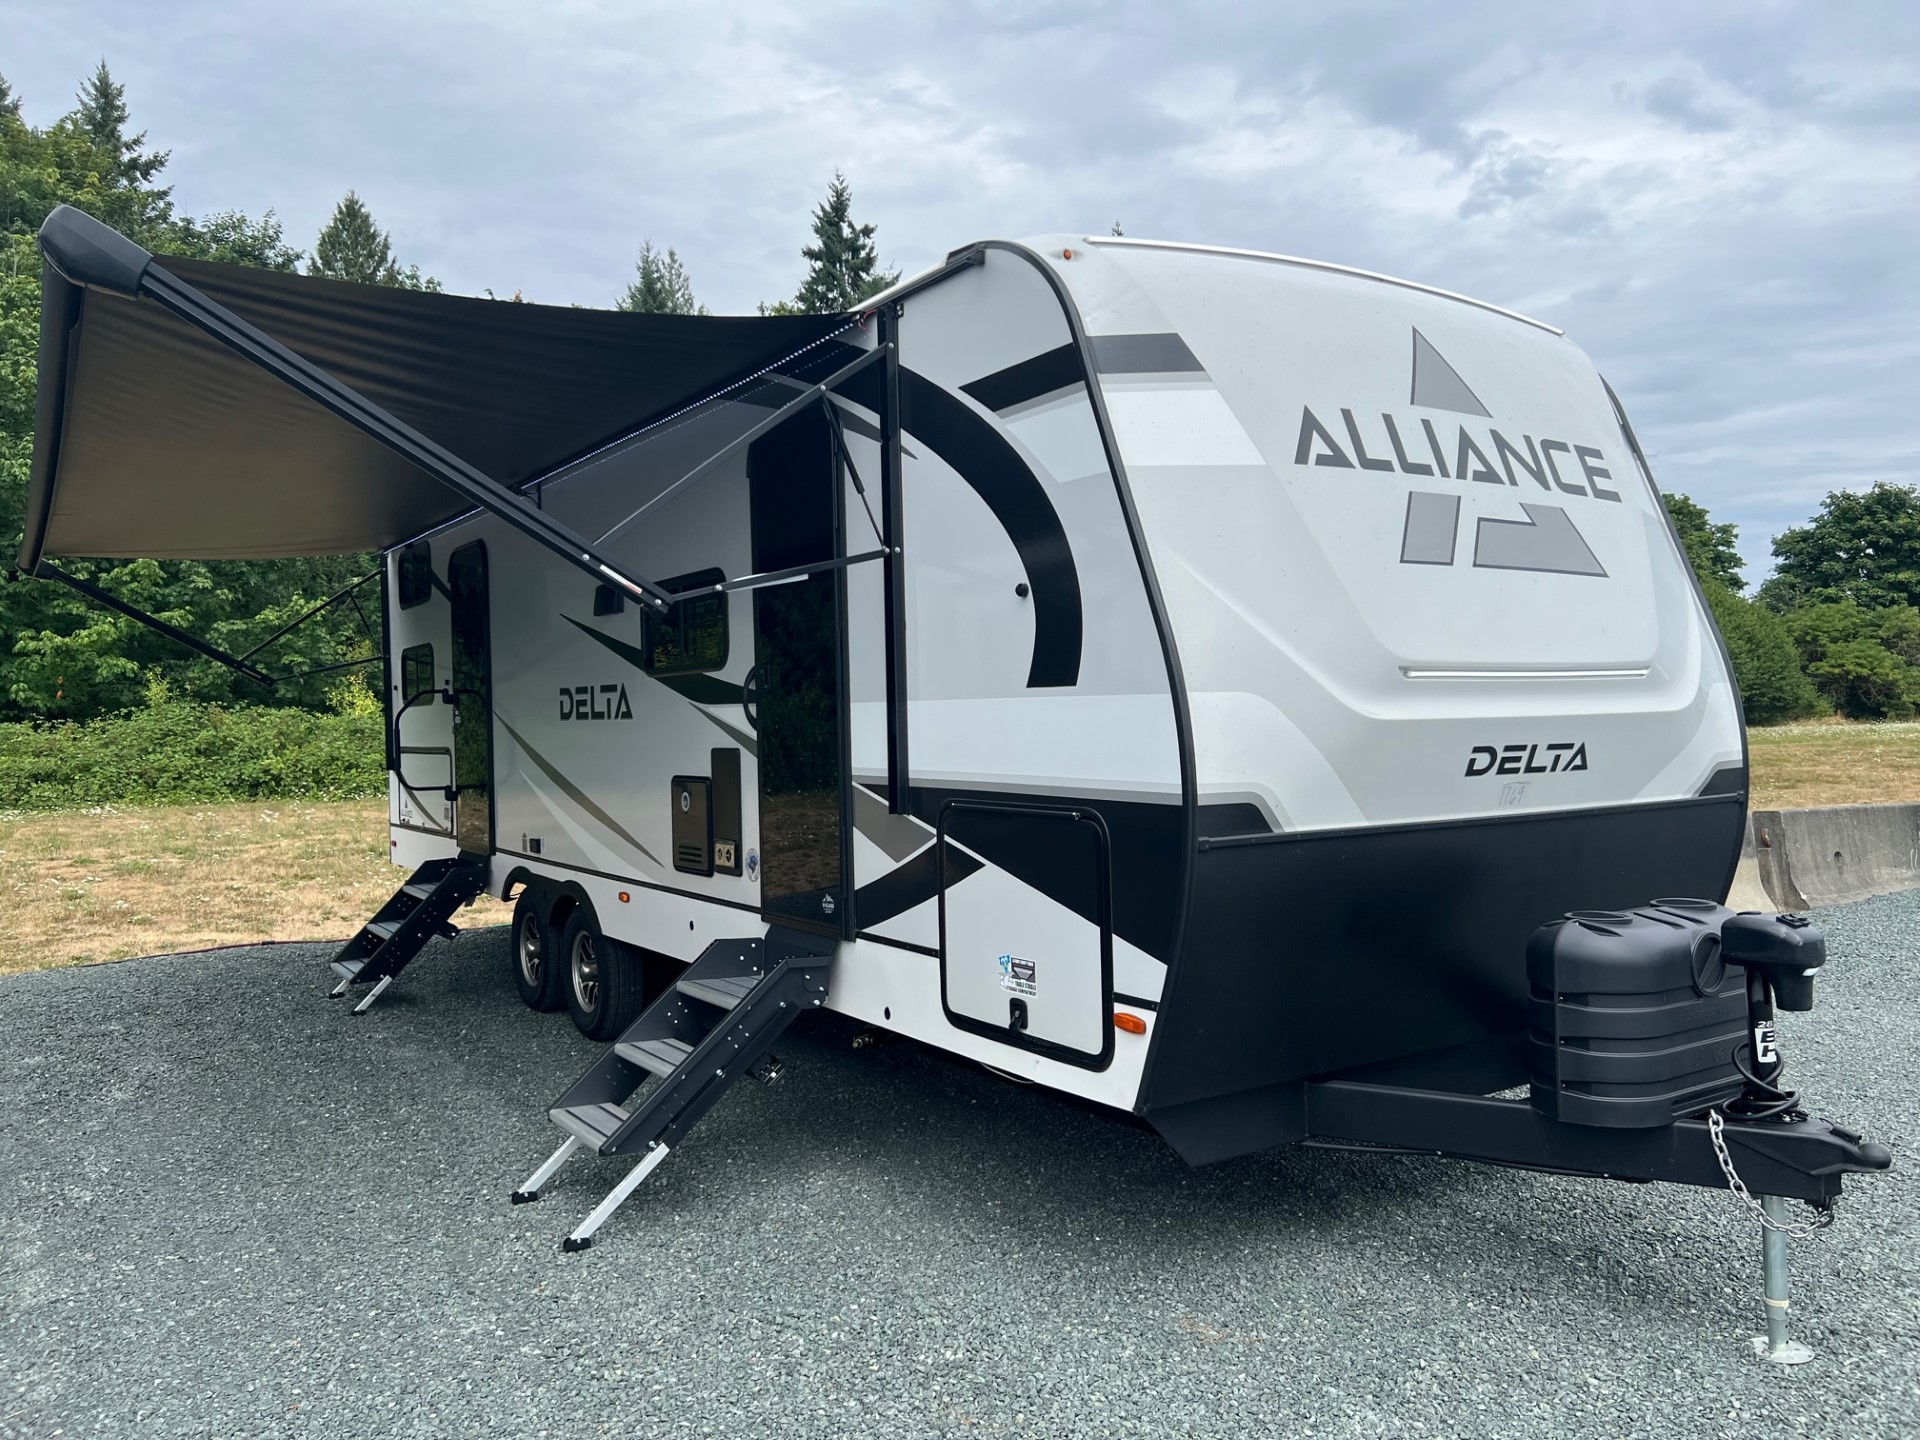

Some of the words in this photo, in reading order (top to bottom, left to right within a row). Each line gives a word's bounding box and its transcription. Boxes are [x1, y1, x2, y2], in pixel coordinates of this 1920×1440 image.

[1294, 404, 1622, 503] ALLIANCE
[560, 682, 633, 721] DELTA
[1464, 741, 1588, 777] DELTA
